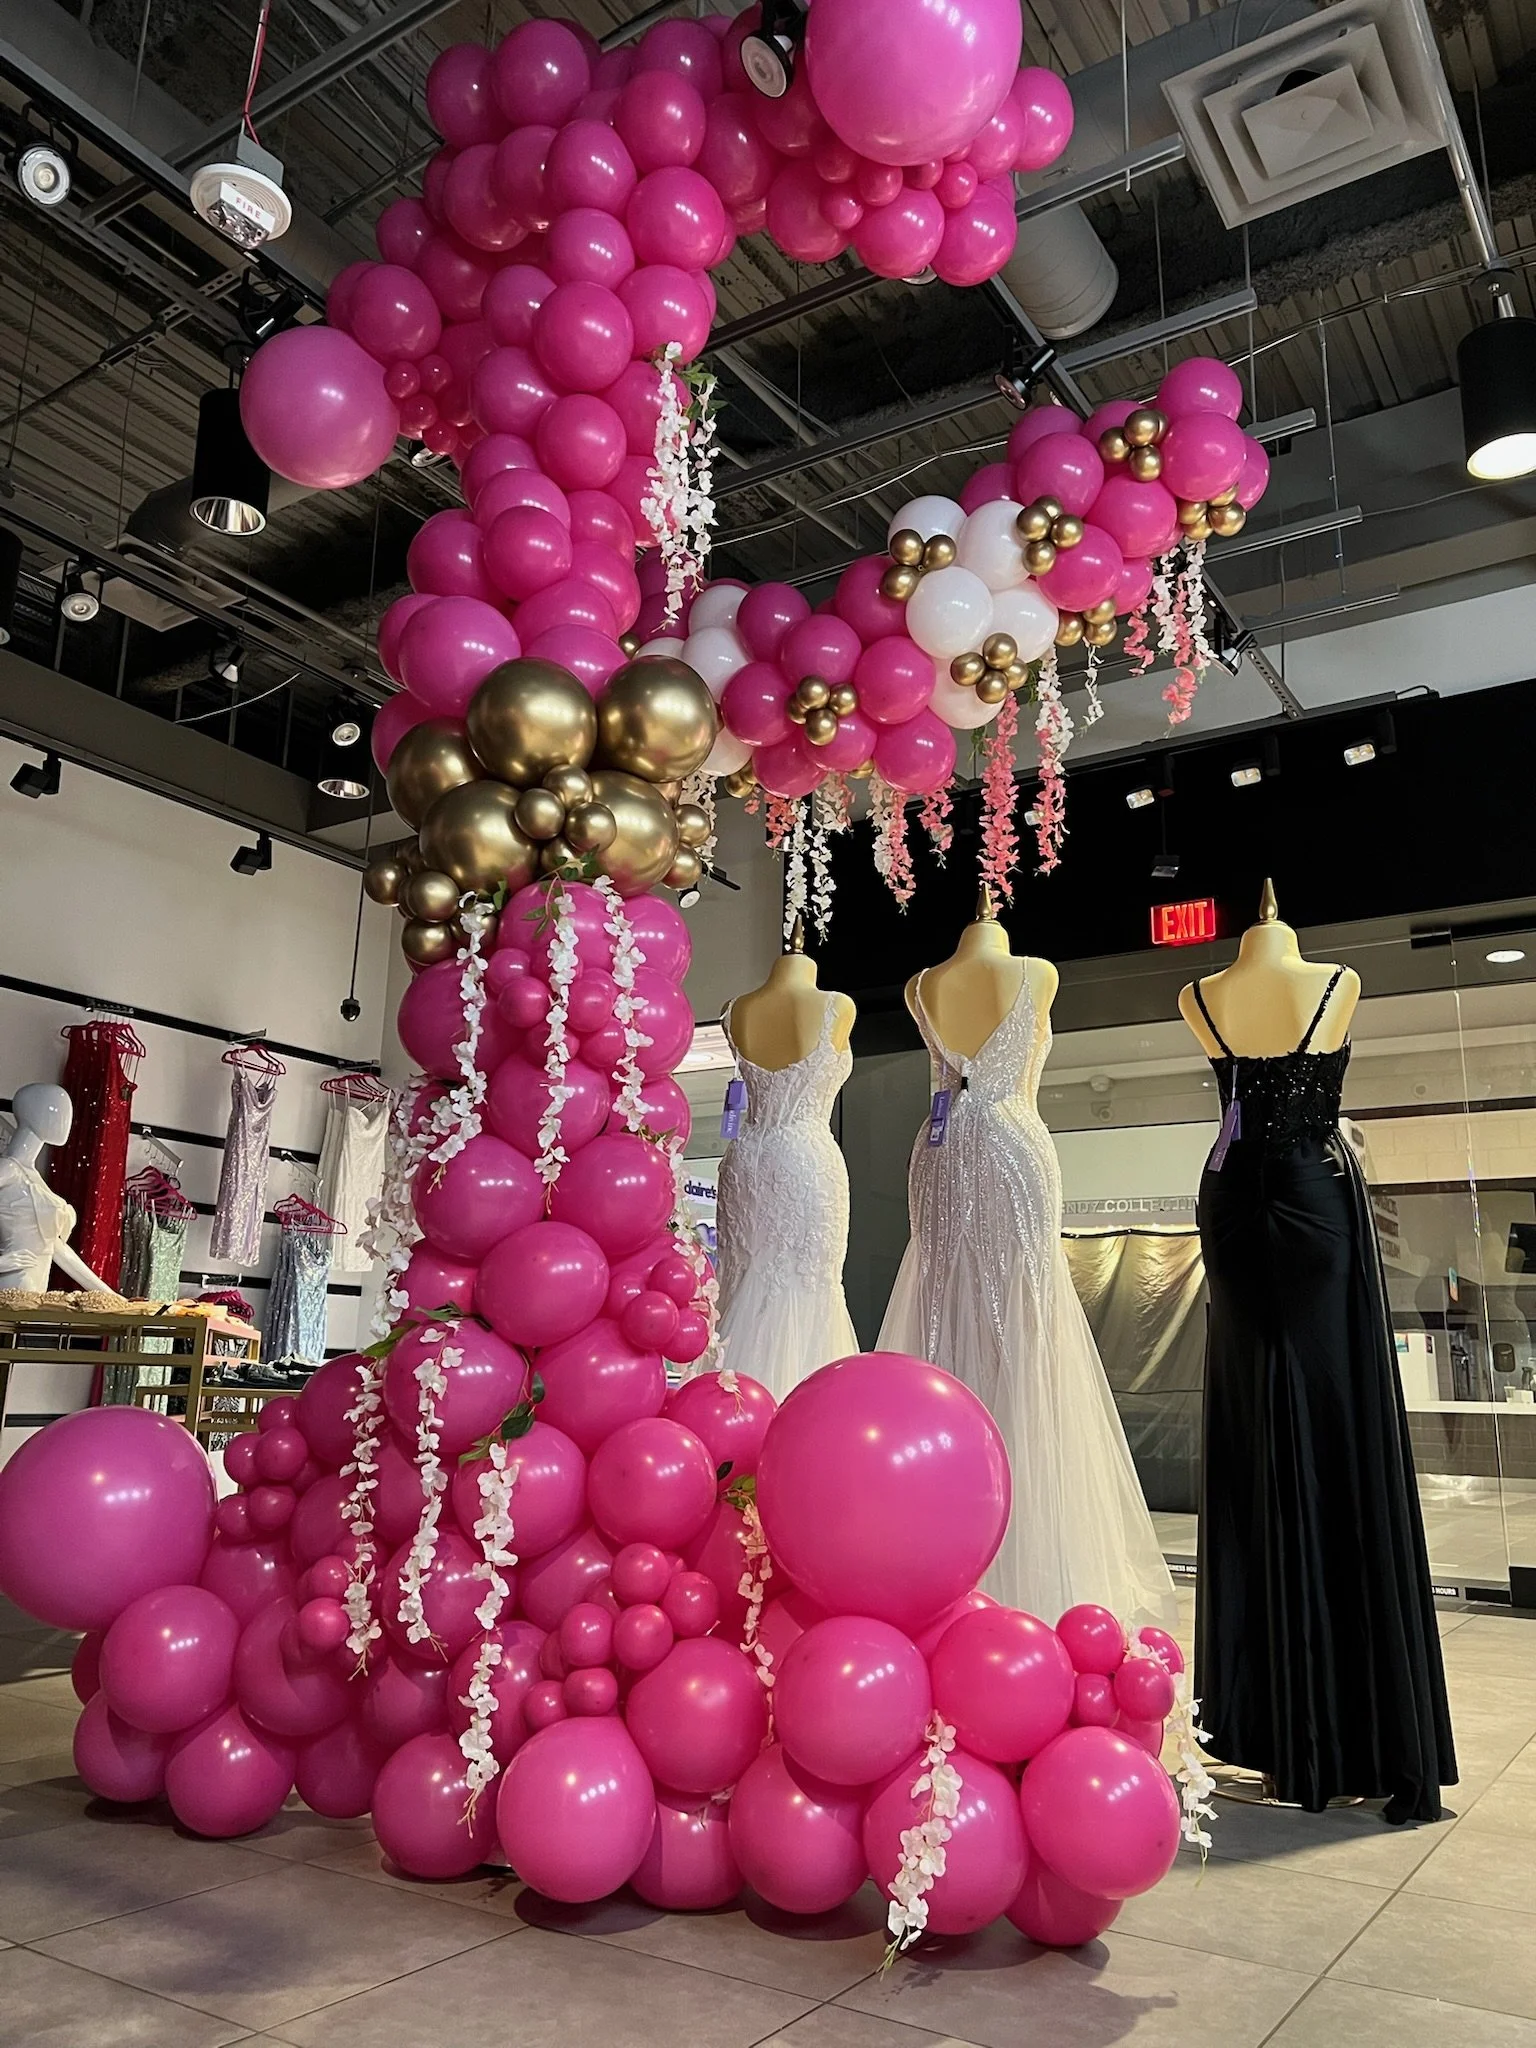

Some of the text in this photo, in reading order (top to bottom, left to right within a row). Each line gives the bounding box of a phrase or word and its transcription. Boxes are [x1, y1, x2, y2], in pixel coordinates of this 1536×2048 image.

[235, 196, 261, 219] FIRE
[1161, 901, 1208, 941] EXIT
[684, 1180, 717, 1199] claire's
